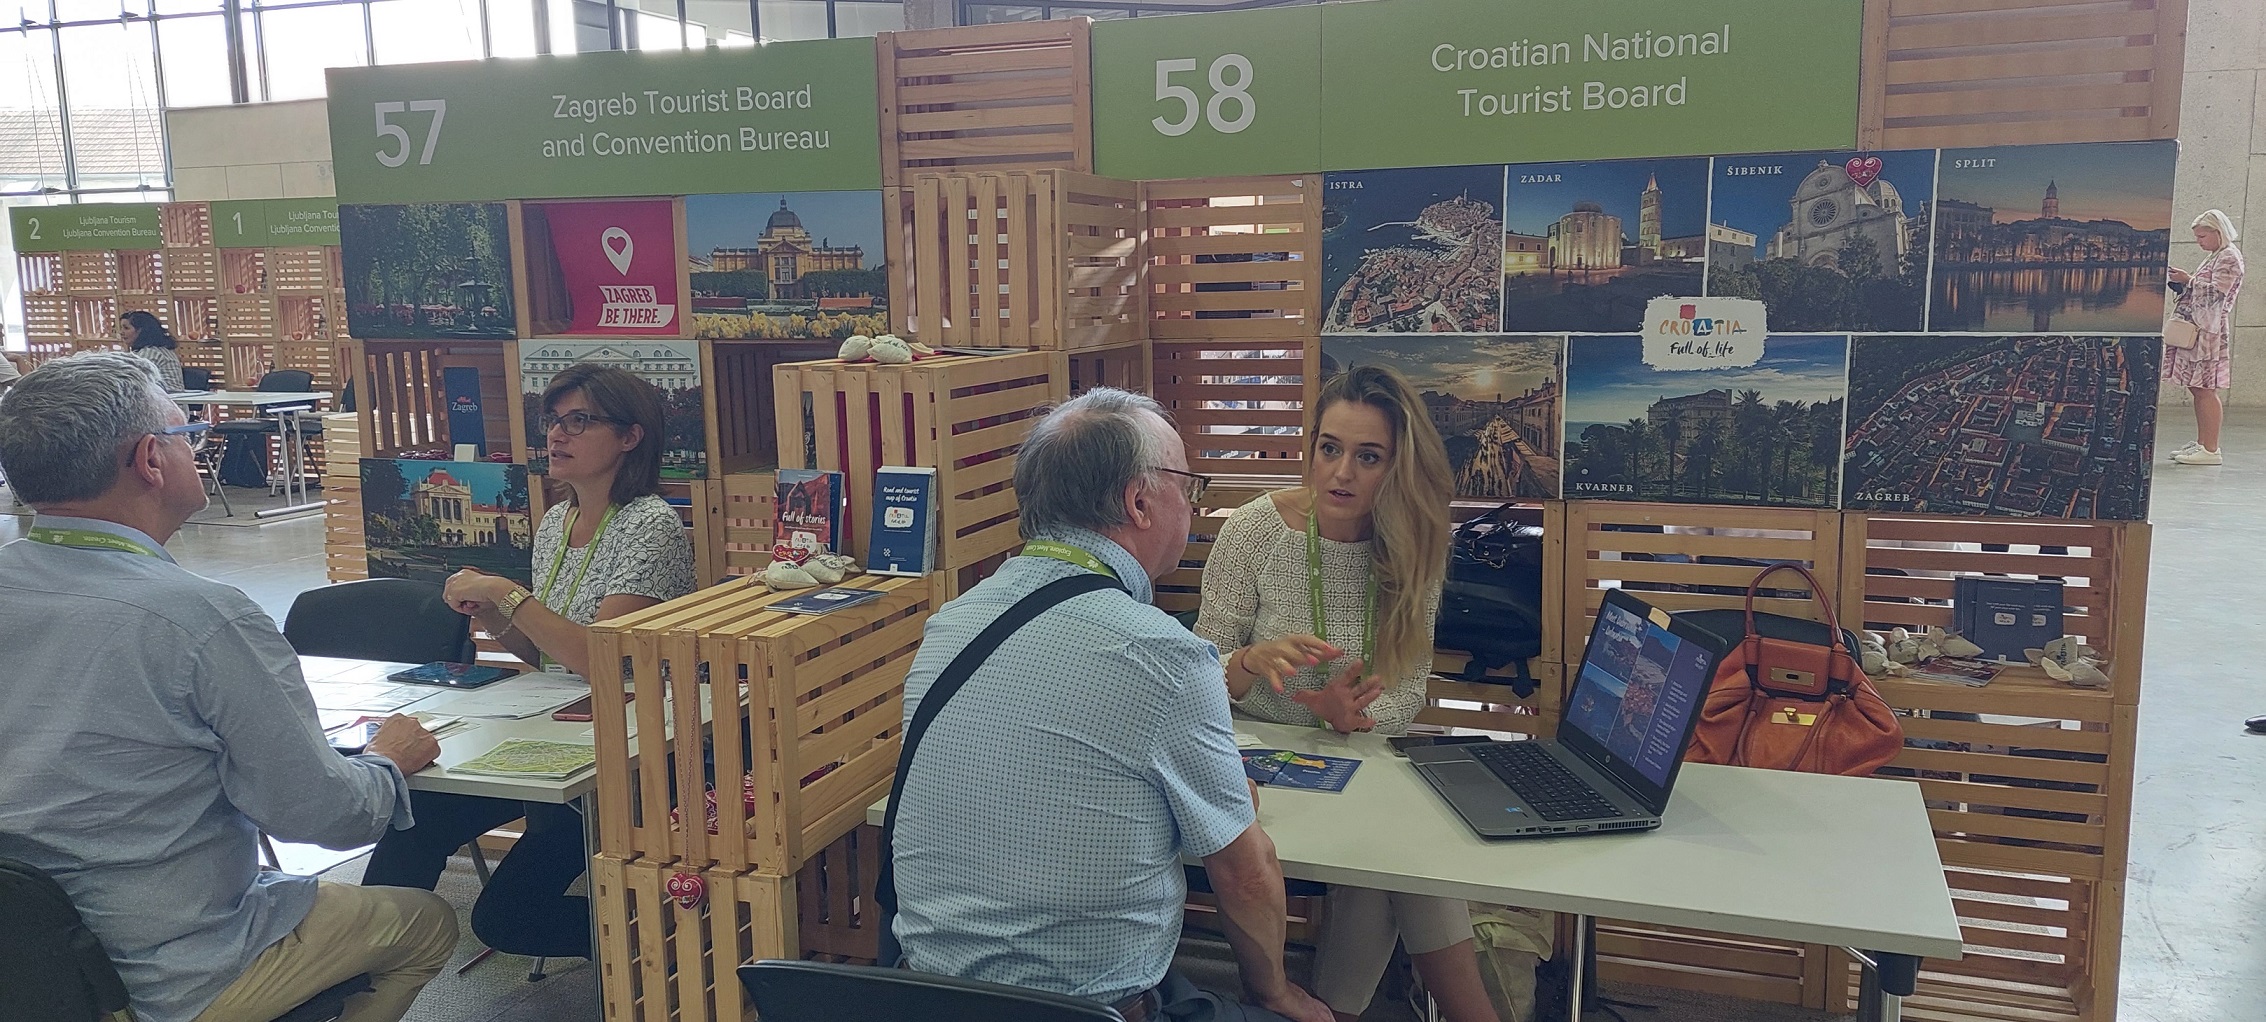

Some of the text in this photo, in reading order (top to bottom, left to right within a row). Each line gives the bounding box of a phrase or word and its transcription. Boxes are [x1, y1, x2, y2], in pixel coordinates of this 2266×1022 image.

[1430, 23, 1731, 74] Croatian National
[1150, 52, 1258, 138] 58
[1457, 76, 1688, 117] Tourist Board
[552, 83, 812, 124] Zagreb Tourist Board
[374, 99, 447, 168] 57
[542, 126, 831, 157] and Convention Bureau
[1727, 164, 1783, 177] ŠIBENIK
[1955, 158, 1996, 169] SPLIT
[1330, 181, 1364, 190] ISTRA
[1520, 173, 1562, 184] ZADAR
[79, 216, 137, 226] Ljubljana Tourism
[288, 210, 321, 222] Ljubljana
[28, 218, 41, 240] 2
[232, 212, 243, 236] 1
[270, 224, 302, 235] Ljubljana
[63, 227, 157, 238] Ljubljana Convention Bureau
[605, 288, 652, 303] ZAGREB
[605, 308, 661, 324] BE THERE.
[1659, 317, 1747, 337] CROATIA
[1670, 341, 1734, 357] Full of life
[452, 402, 478, 413] Zagreb
[1575, 482, 1634, 493] KVARNER
[1856, 492, 1910, 502] ZAGREB
[782, 511, 826, 525] Full of stories
